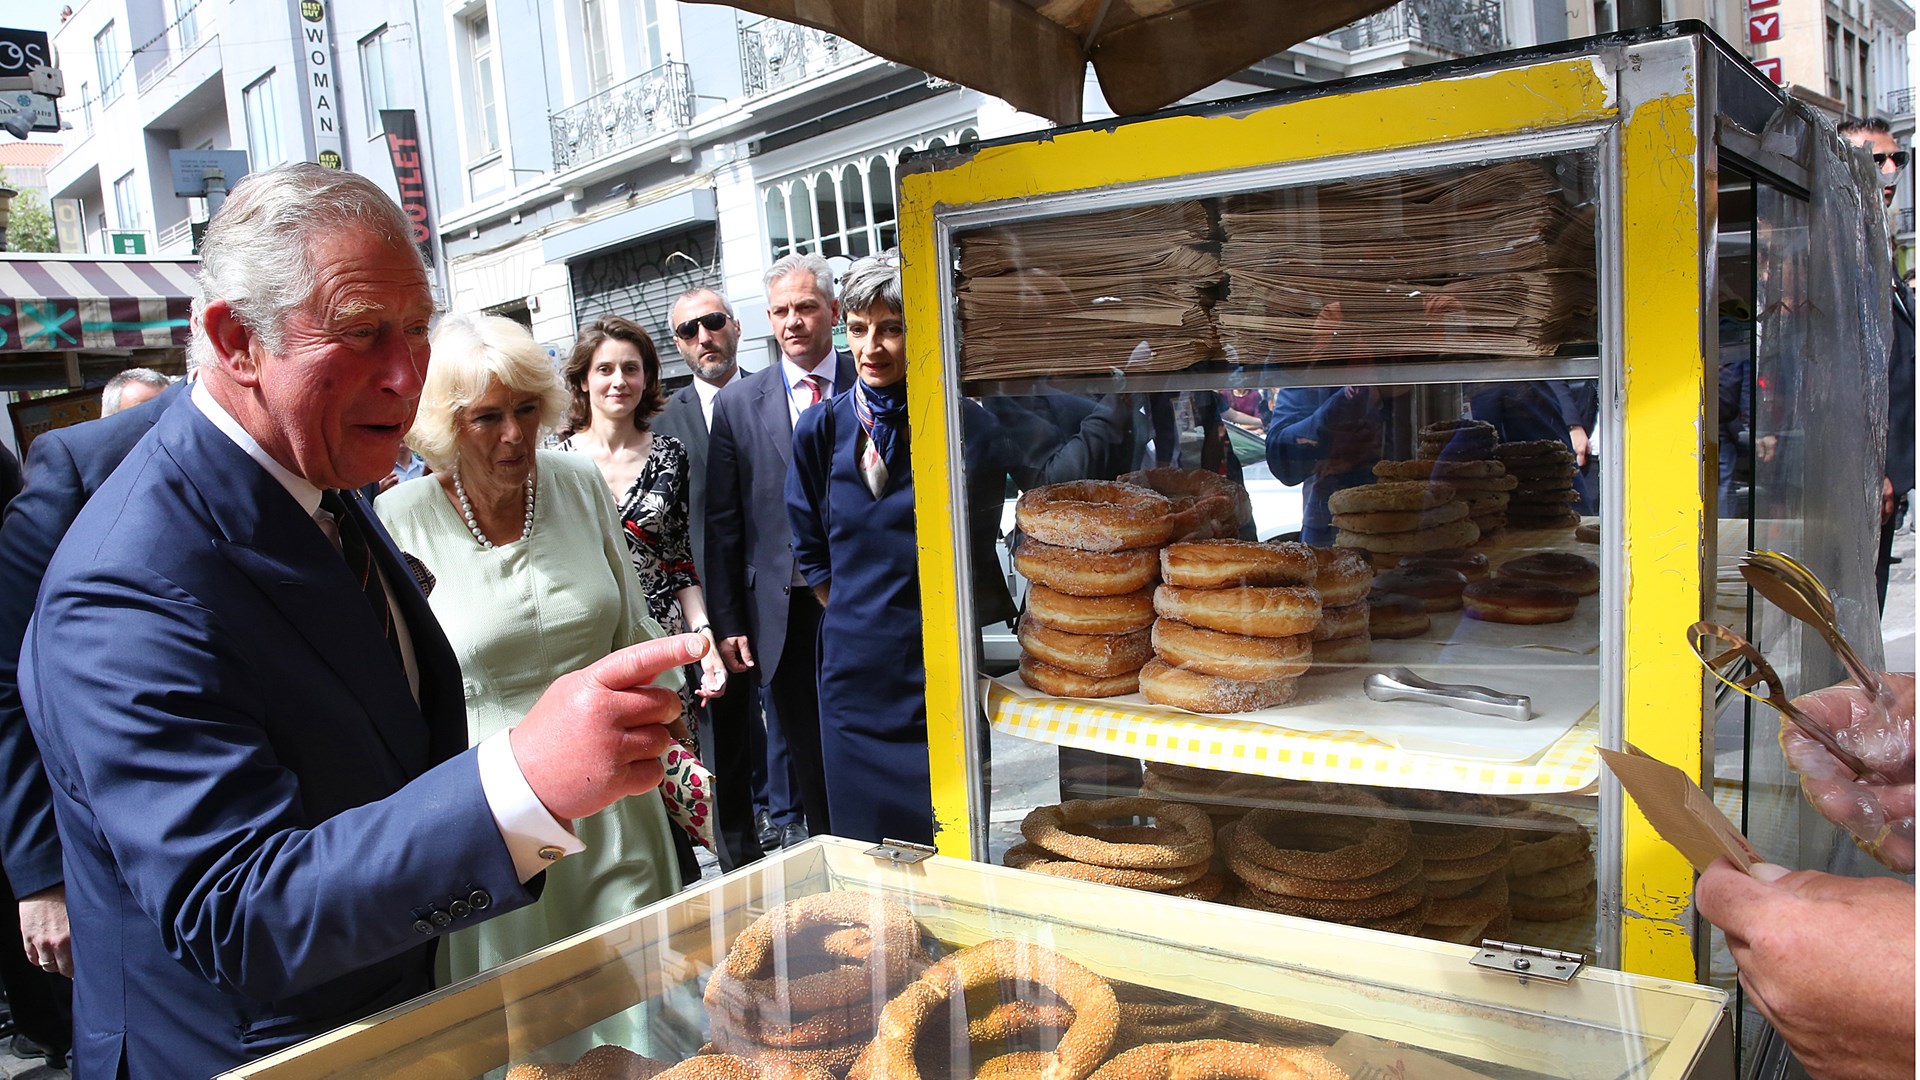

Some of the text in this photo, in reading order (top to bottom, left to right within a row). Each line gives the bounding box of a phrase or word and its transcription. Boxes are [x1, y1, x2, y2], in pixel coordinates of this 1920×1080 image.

[302, 2, 321, 10] BEST
[305, 28, 333, 132] WOMAN
[320, 154, 338, 162] BEST
[388, 133, 430, 242] OUTLET
